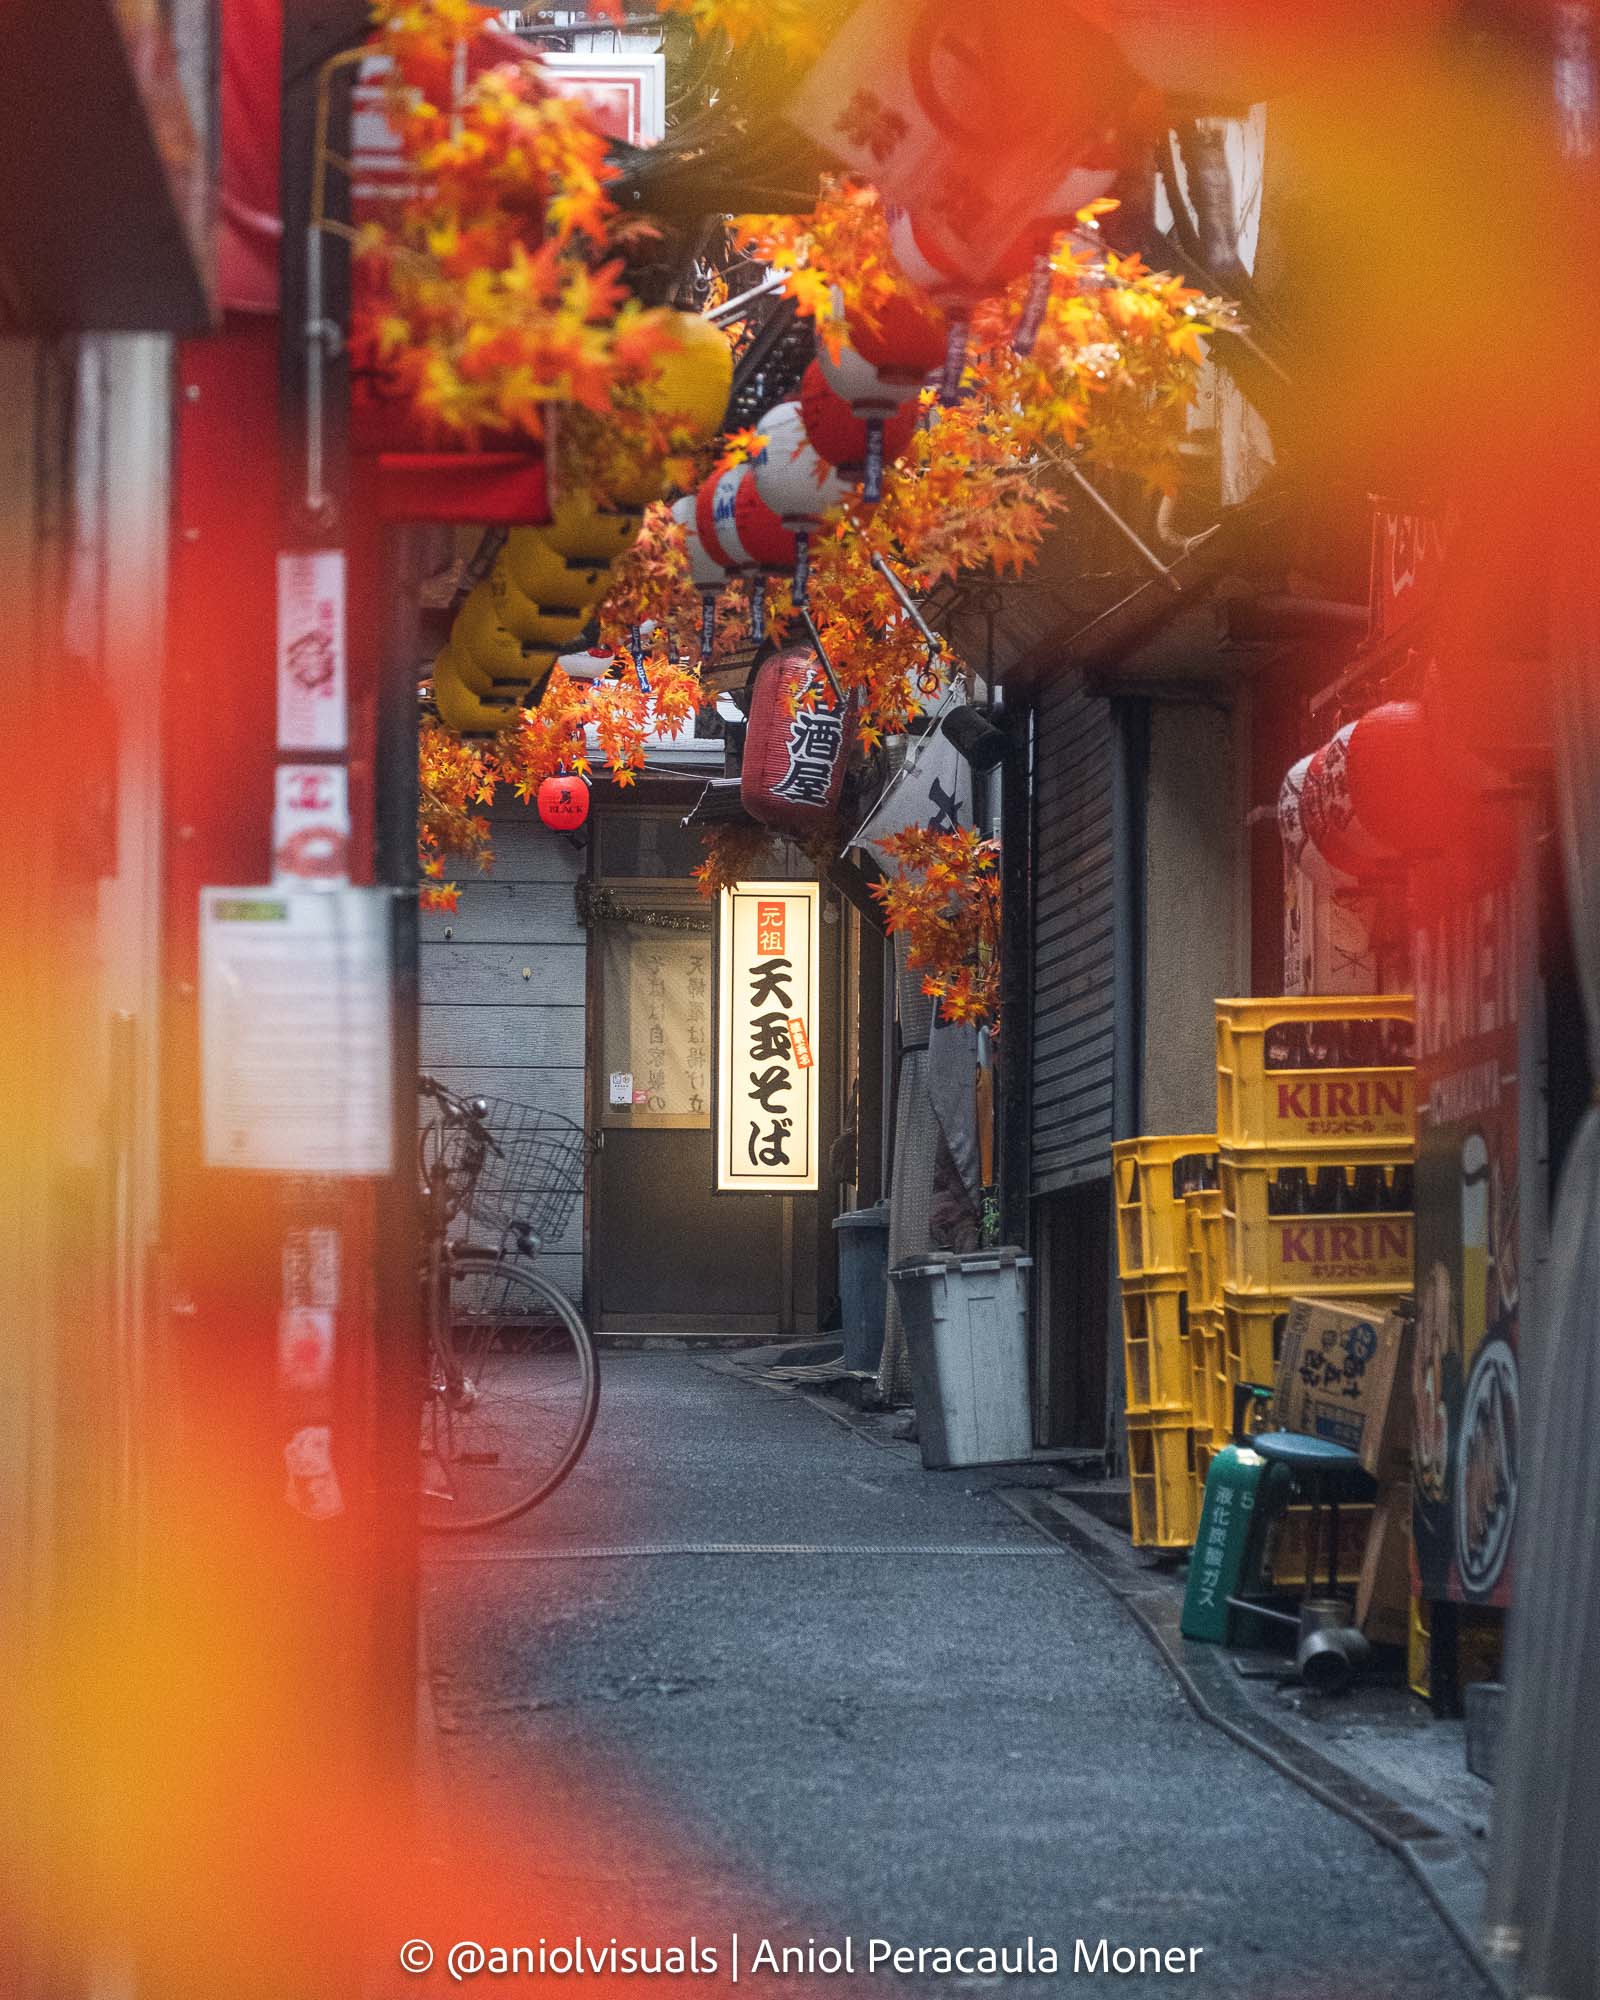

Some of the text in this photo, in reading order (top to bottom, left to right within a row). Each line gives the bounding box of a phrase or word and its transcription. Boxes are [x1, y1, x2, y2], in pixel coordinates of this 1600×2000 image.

[760, 907, 783, 951] 元祖
[748, 958, 792, 1167] 天玉そば
[1277, 1080, 1404, 1119] KIRIN
[1281, 1222, 1409, 1264] KIRIN
[1198, 1485, 1235, 1608] 液化炭酸ガス
